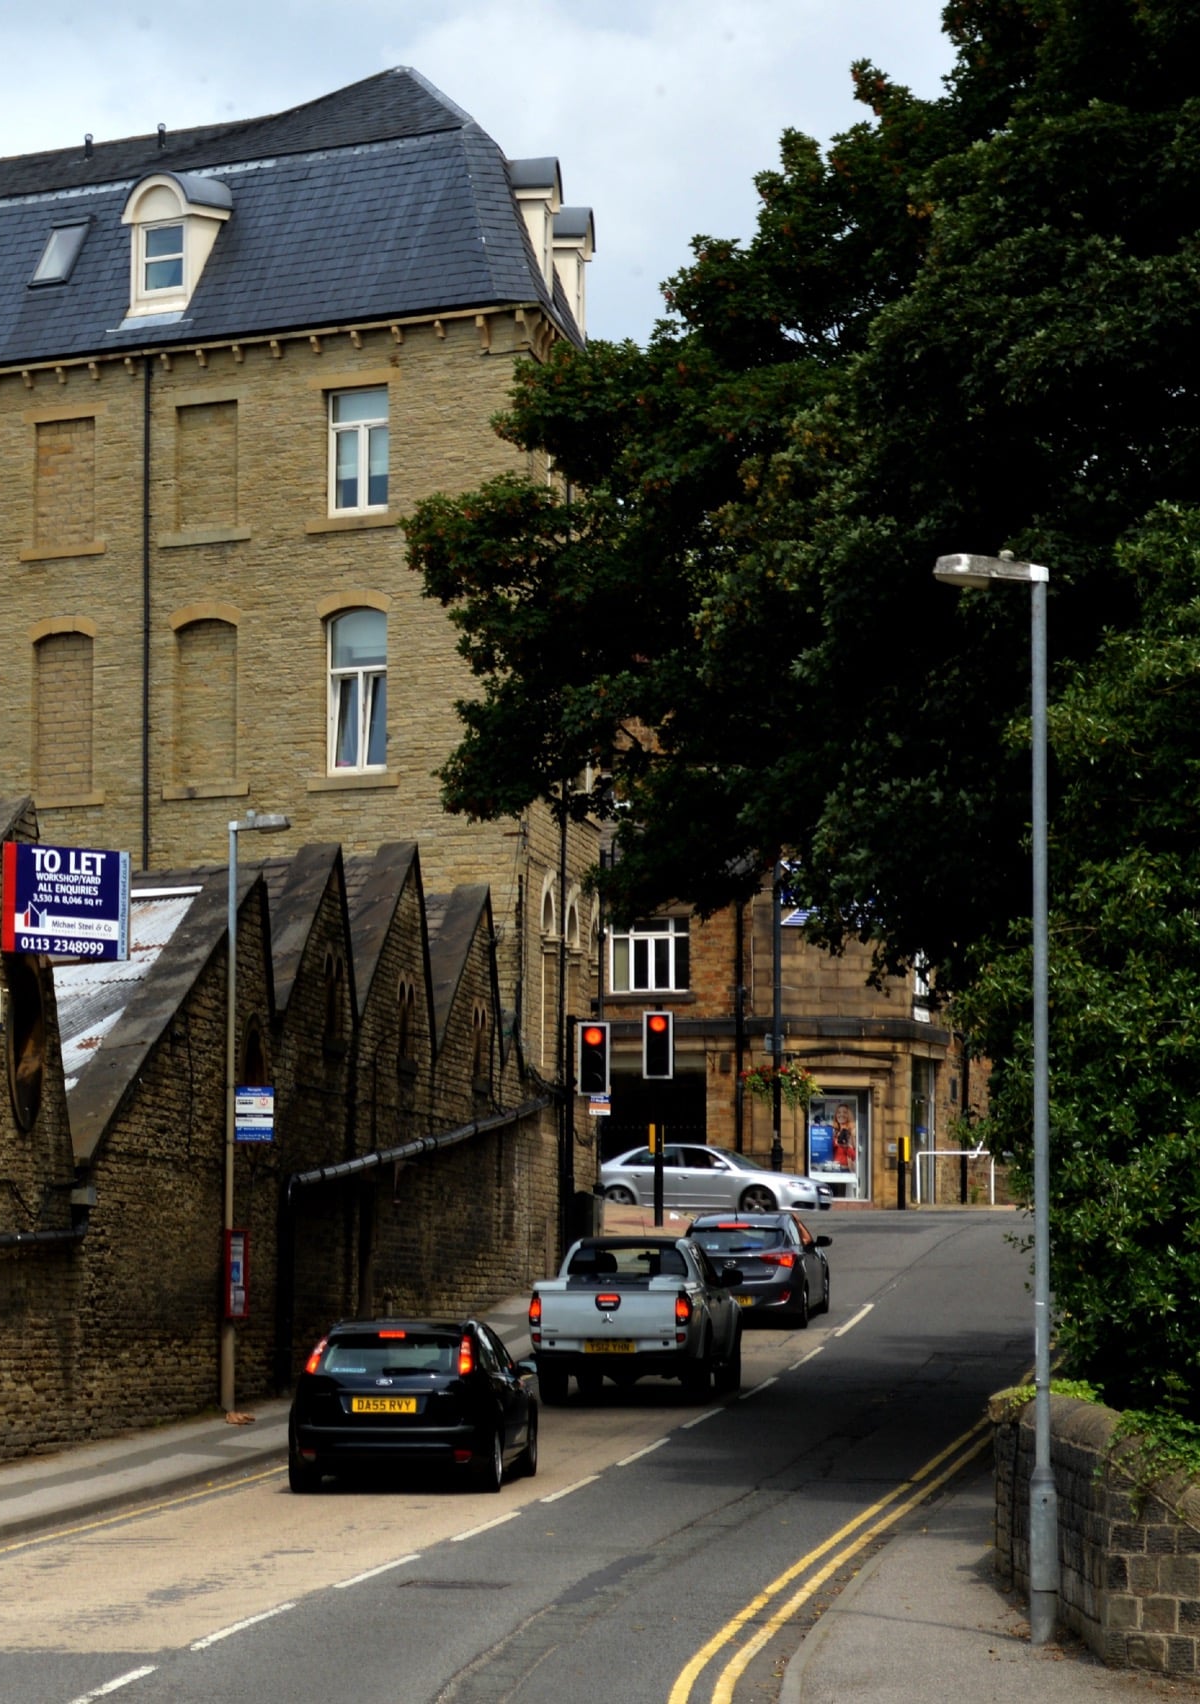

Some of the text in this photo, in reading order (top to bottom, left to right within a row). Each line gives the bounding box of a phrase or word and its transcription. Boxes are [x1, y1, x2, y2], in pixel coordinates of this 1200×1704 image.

[31, 848, 106, 876] TO LET
[36, 872, 101, 884] WORKSHOP/YARD
[38, 883, 99, 896] ALL ENQUIRIES
[33, 893, 53, 903] 3,530
[54, 895, 61, 904] &
[84, 898, 94, 907] SQ
[95, 899, 104, 907] FT
[51, 920, 112, 932] Michael Steel & Co
[21, 936, 104, 955] 0113 2348999
[357, 1399, 411, 1410] DA55 RVY
